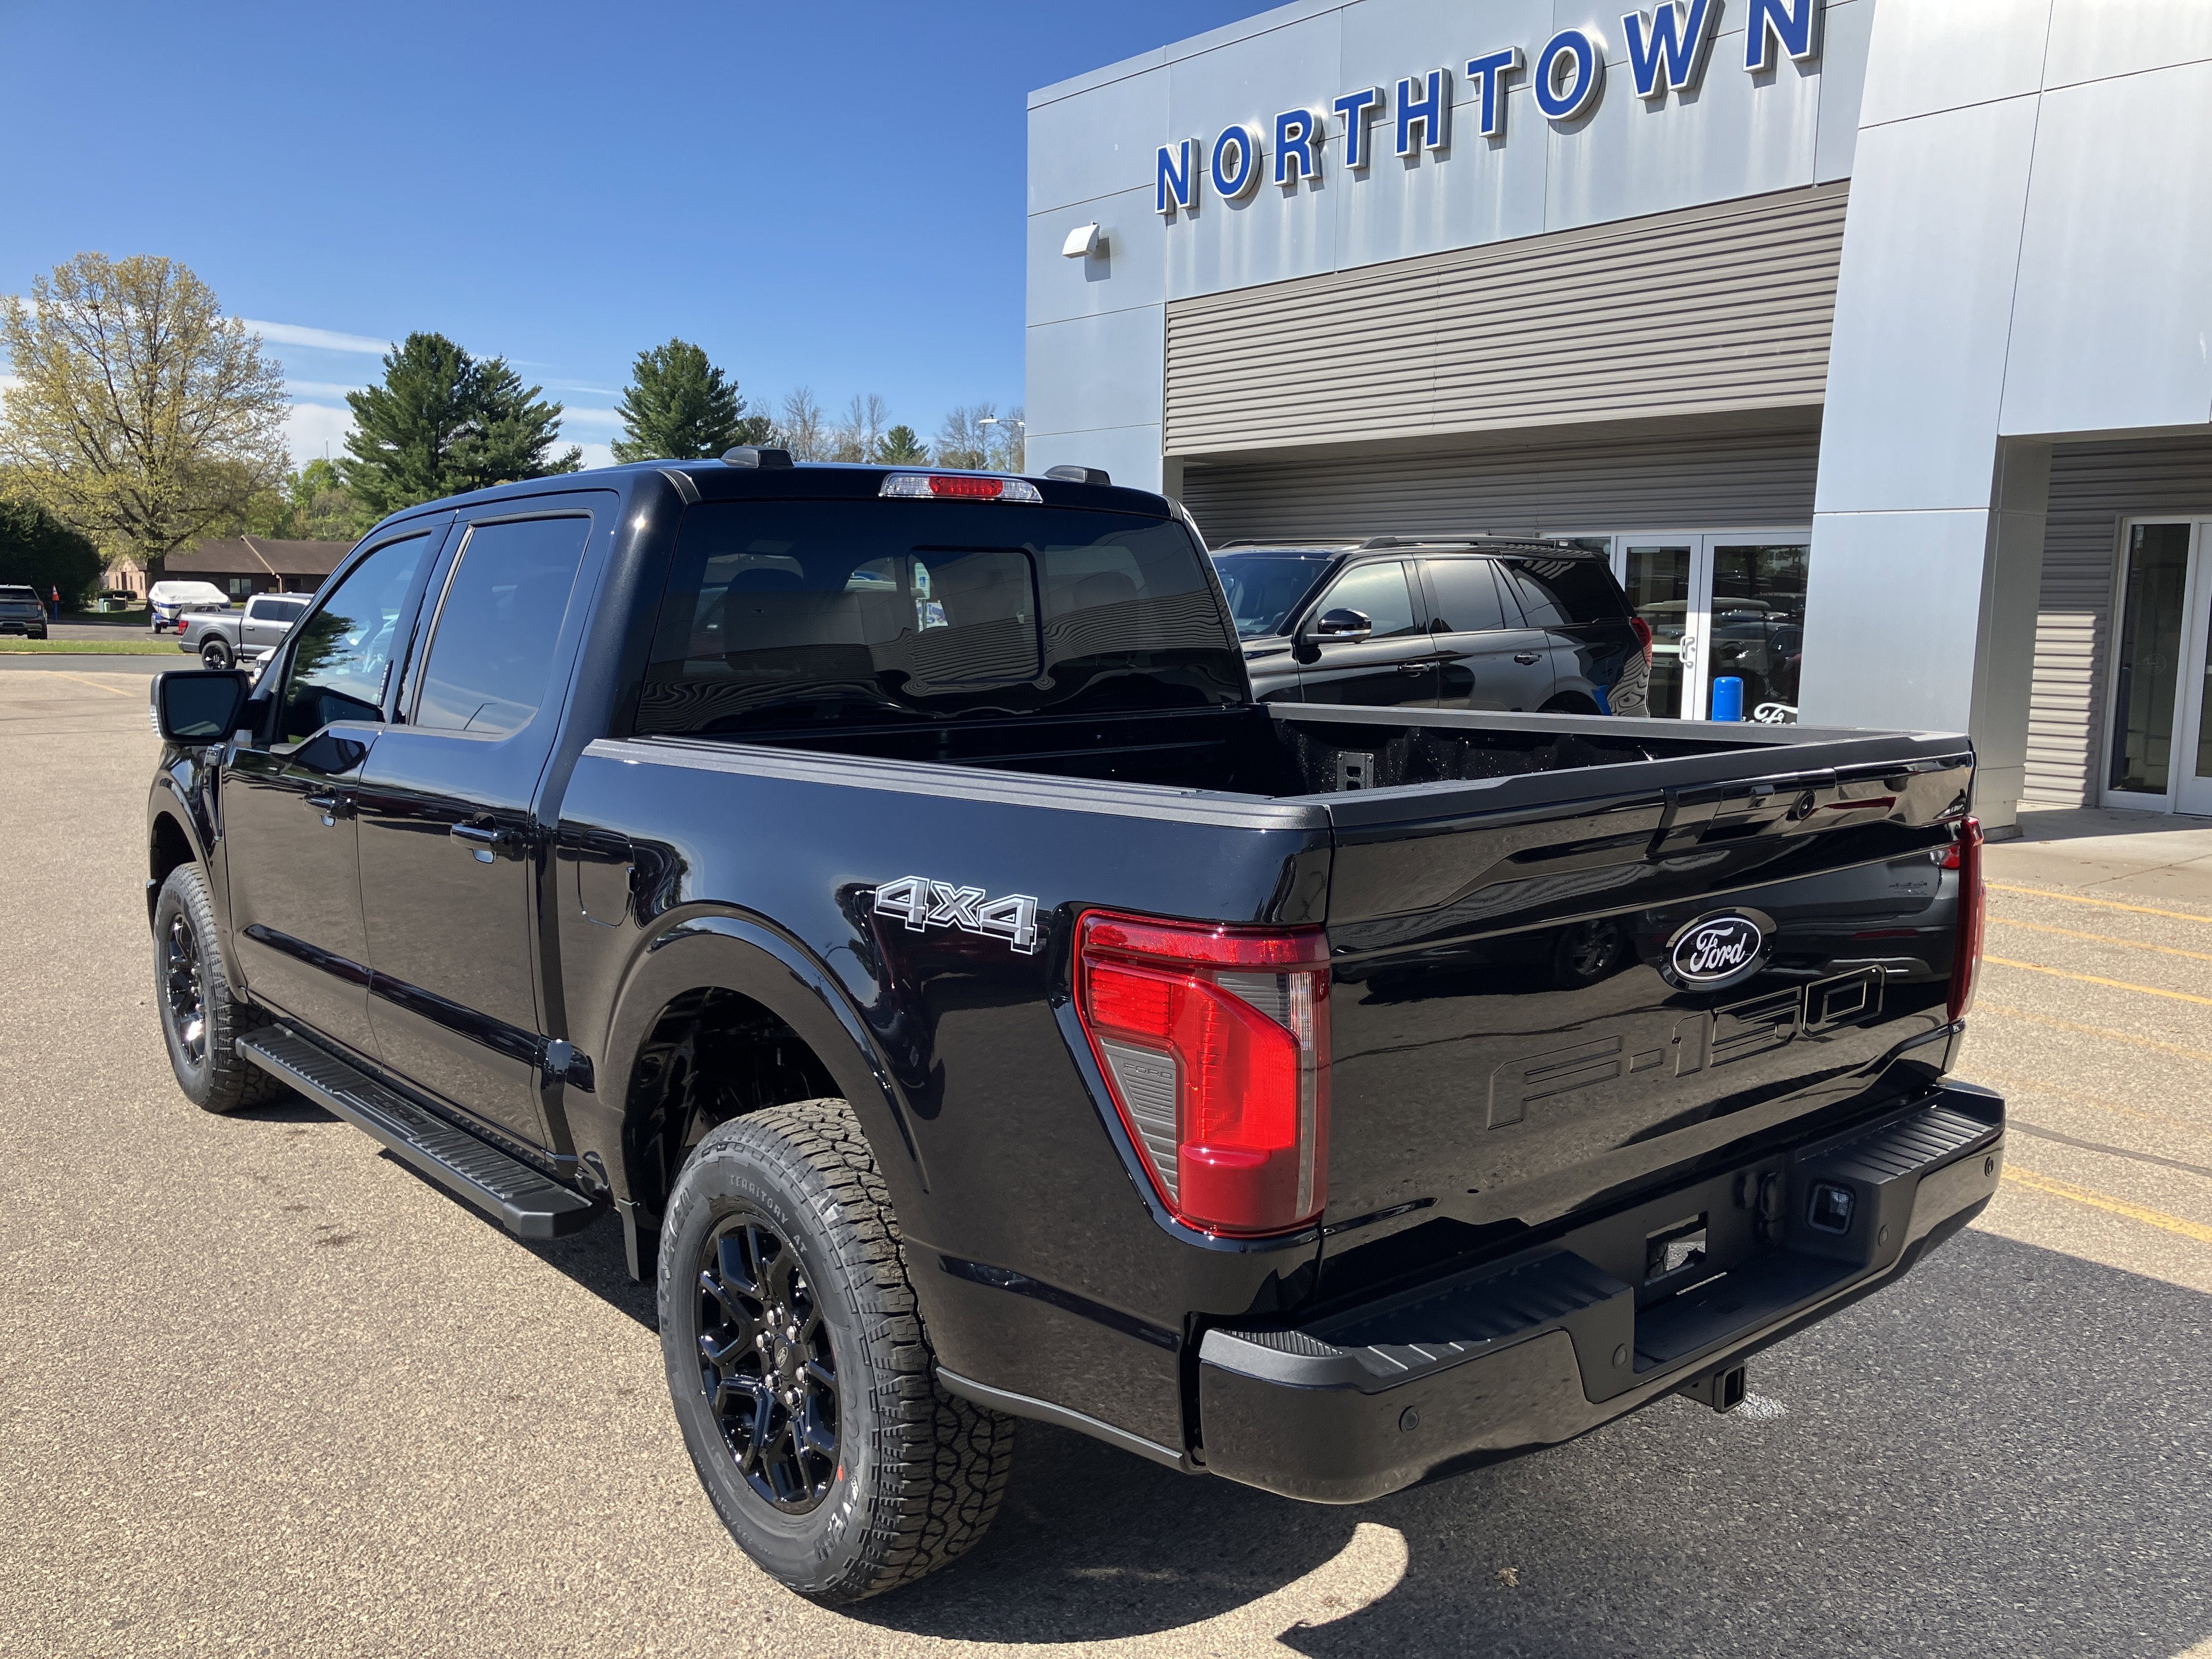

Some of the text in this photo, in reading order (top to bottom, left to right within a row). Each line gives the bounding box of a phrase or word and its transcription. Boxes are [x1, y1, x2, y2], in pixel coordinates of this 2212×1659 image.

[1155, 0, 1819, 215] NORTHTOWN
[1690, 926, 1747, 972] Ford
[1123, 1062, 1173, 1080] FORD
[1487, 963, 1887, 1130] F-150
[729, 1173, 808, 1253] TERRITORY AT
